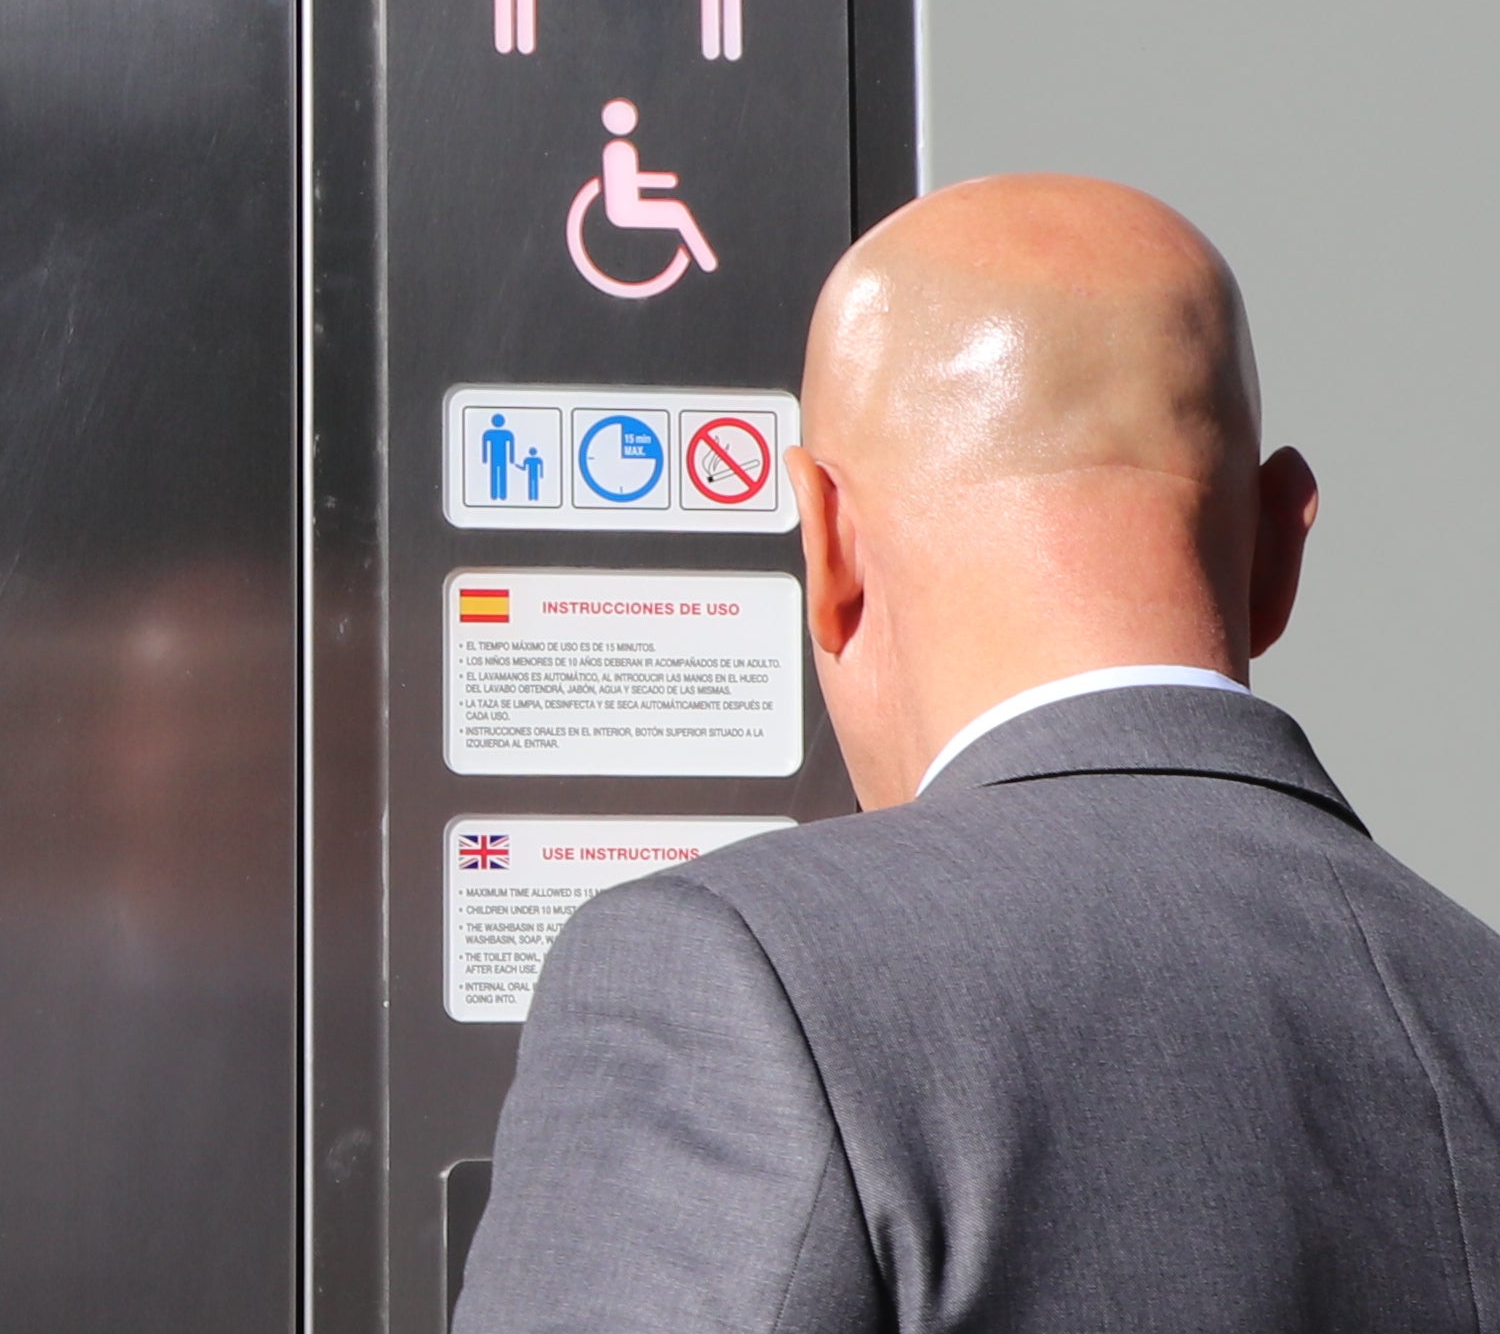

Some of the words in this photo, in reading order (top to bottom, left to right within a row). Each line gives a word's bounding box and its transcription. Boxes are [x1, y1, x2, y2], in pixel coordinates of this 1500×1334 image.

[624, 433, 634, 444] 15
[635, 434, 652, 444] min
[624, 446, 646, 456] MAX.
[542, 601, 674, 616] INSTRUCCIONES
[679, 602, 700, 616] DE
[706, 603, 739, 616] USO
[466, 642, 475, 651] EL
[478, 642, 510, 651] TIEMPO
[511, 640, 545, 651] MÁXIMO
[546, 642, 558, 651] DE
[560, 642, 578, 652] USO
[579, 642, 590, 652] ES
[591, 643, 603, 652] DE
[605, 643, 614, 652] 15
[466, 657, 483, 666] LOS
[484, 655, 510, 666] NIÑOS
[512, 657, 553, 667] MENORES
[554, 658, 566, 667] DE
[568, 658, 577, 667] 10
[578, 656, 602, 667] AÑOS
[644, 658, 653, 667] IR
[654, 656, 718, 668] ACOMPAÑADOS
[719, 659, 731, 668] DE
[732, 659, 745, 668] UN
[466, 672, 476, 682] EL
[478, 672, 529, 682] LAVAMANOS
[530, 673, 542, 682] ES
[601, 673, 611, 682] AL
[613, 673, 664, 682] INTRODUCIR
[665, 674, 681, 683] LAS
[682, 674, 713, 683] MANOS
[714, 674, 726, 683] EN
[727, 674, 736, 683] EL
[738, 674, 768, 683] HUECO
[465, 684, 481, 693] DEL
[483, 684, 516, 694] LAVABO
[598, 685, 621, 694] AGUA
[623, 685, 628, 694] Y
[630, 685, 665, 694] SECADO
[666, 686, 677, 695] DE
[679, 686, 695, 695] LAS
[465, 700, 476, 709] LA
[478, 700, 499, 709] TAZA
[500, 700, 511, 709] SE
[544, 700, 595, 710] DESINFECTA
[597, 701, 602, 710] Y
[603, 701, 614, 710] SE
[616, 701, 638, 710] SECA
[640, 699, 720, 710] AUTOMÁTICAMENTE
[722, 699, 760, 711] DESPUÉS
[761, 702, 773, 711] DE
[465, 712, 489, 721] CADA
[465, 727, 532, 736] INSTRUCCIONES
[533, 727, 566, 737] ORALES
[567, 728, 579, 737] EN
[580, 728, 590, 737] EL
[634, 726, 664, 737] BOTÓN
[665, 728, 707, 738] SUPERIOR
[708, 728, 743, 738] SITUADO
[745, 729, 751, 738] A
[752, 729, 763, 738] LA
[465, 739, 510, 750] IZQUIERDA
[511, 739, 521, 748] AL
[542, 848, 574, 860] USE
[579, 848, 700, 861] INSTRUCTIONS
[466, 888, 508, 897] MAXIMUM
[510, 888, 529, 898] TIME
[531, 888, 572, 898] ALLOWED
[573, 889, 582, 898] IS
[466, 906, 508, 915] CHILDREN
[510, 906, 540, 915] UNDER
[541, 906, 551, 915] 10
[466, 923, 482, 932] THE
[484, 923, 534, 932] WASHBASIN
[536, 923, 544, 932] IS
[465, 953, 481, 962] THE
[483, 953, 511, 962] TOILET
[465, 965, 492, 974] AFTER
[493, 965, 517, 974] EACH
[465, 982, 504, 991] INTERNAL
[507, 982, 529, 992] ORAL
[465, 994, 493, 1004] GOING
